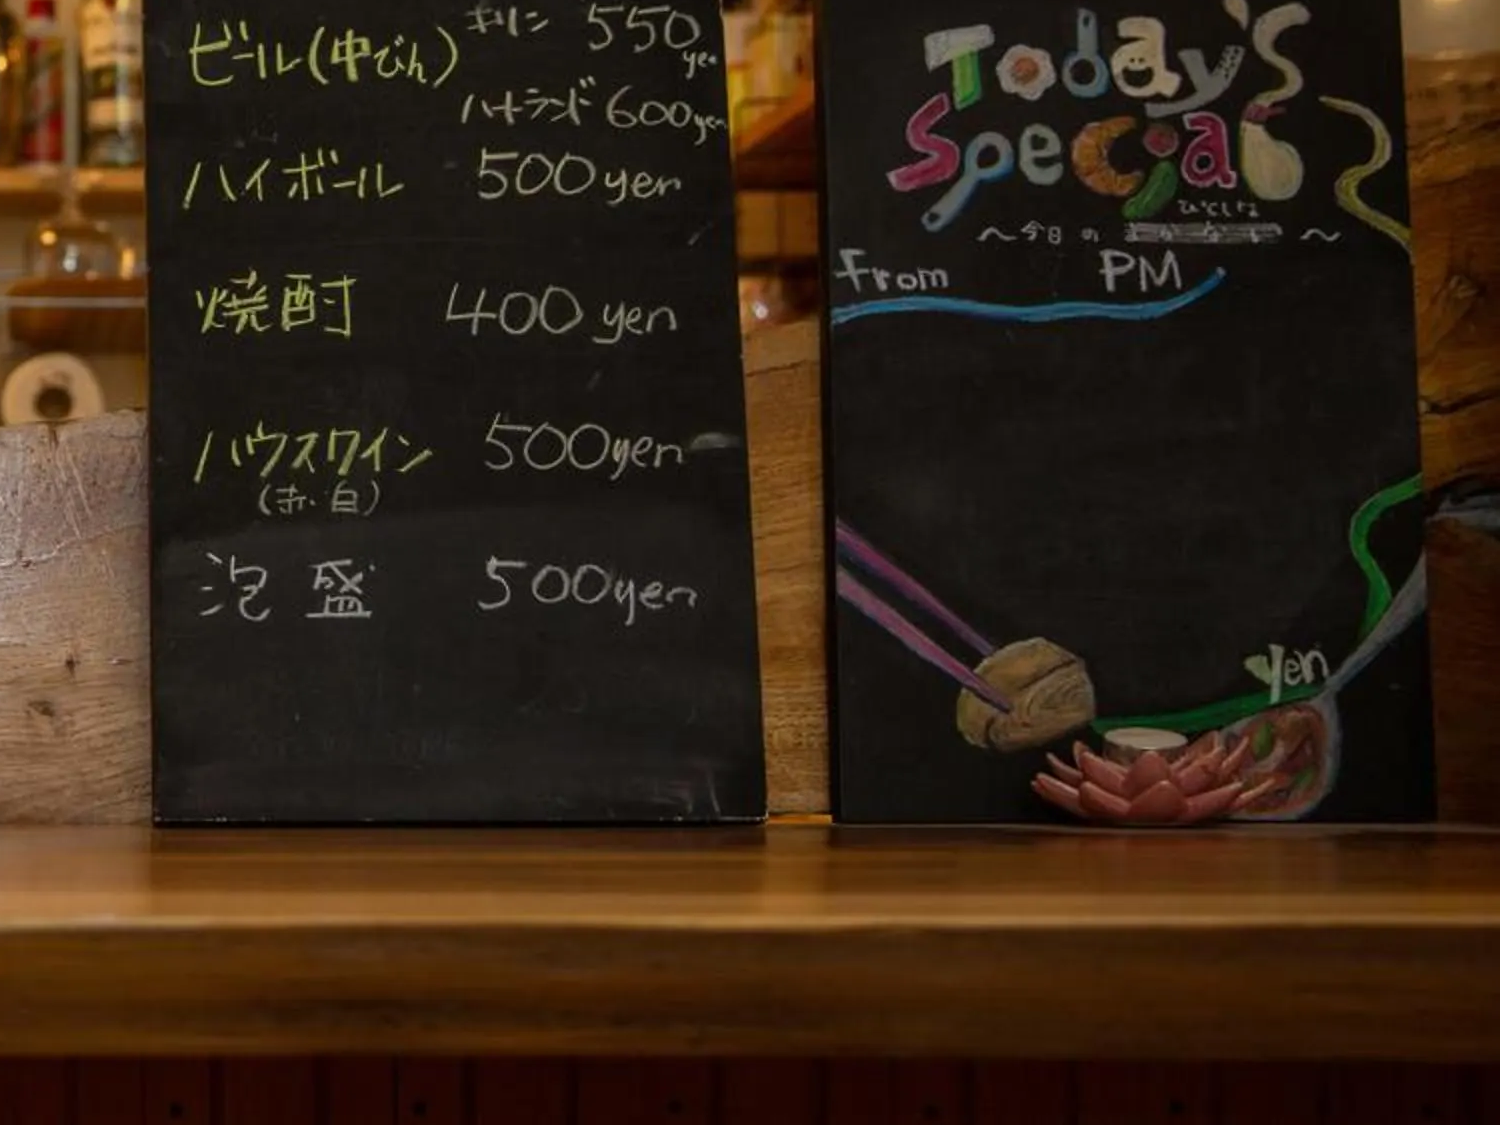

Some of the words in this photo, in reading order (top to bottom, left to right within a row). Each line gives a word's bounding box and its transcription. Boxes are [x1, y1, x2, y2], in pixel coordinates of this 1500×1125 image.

[587, 2, 702, 51] 550
[182, 147, 406, 210] ハイボール
[886, 91, 1304, 233] Special
[834, 248, 950, 293] From
[1099, 249, 1183, 293] PM
[195, 269, 358, 338] 焼酎
[193, 420, 434, 485] ハウスワイン
